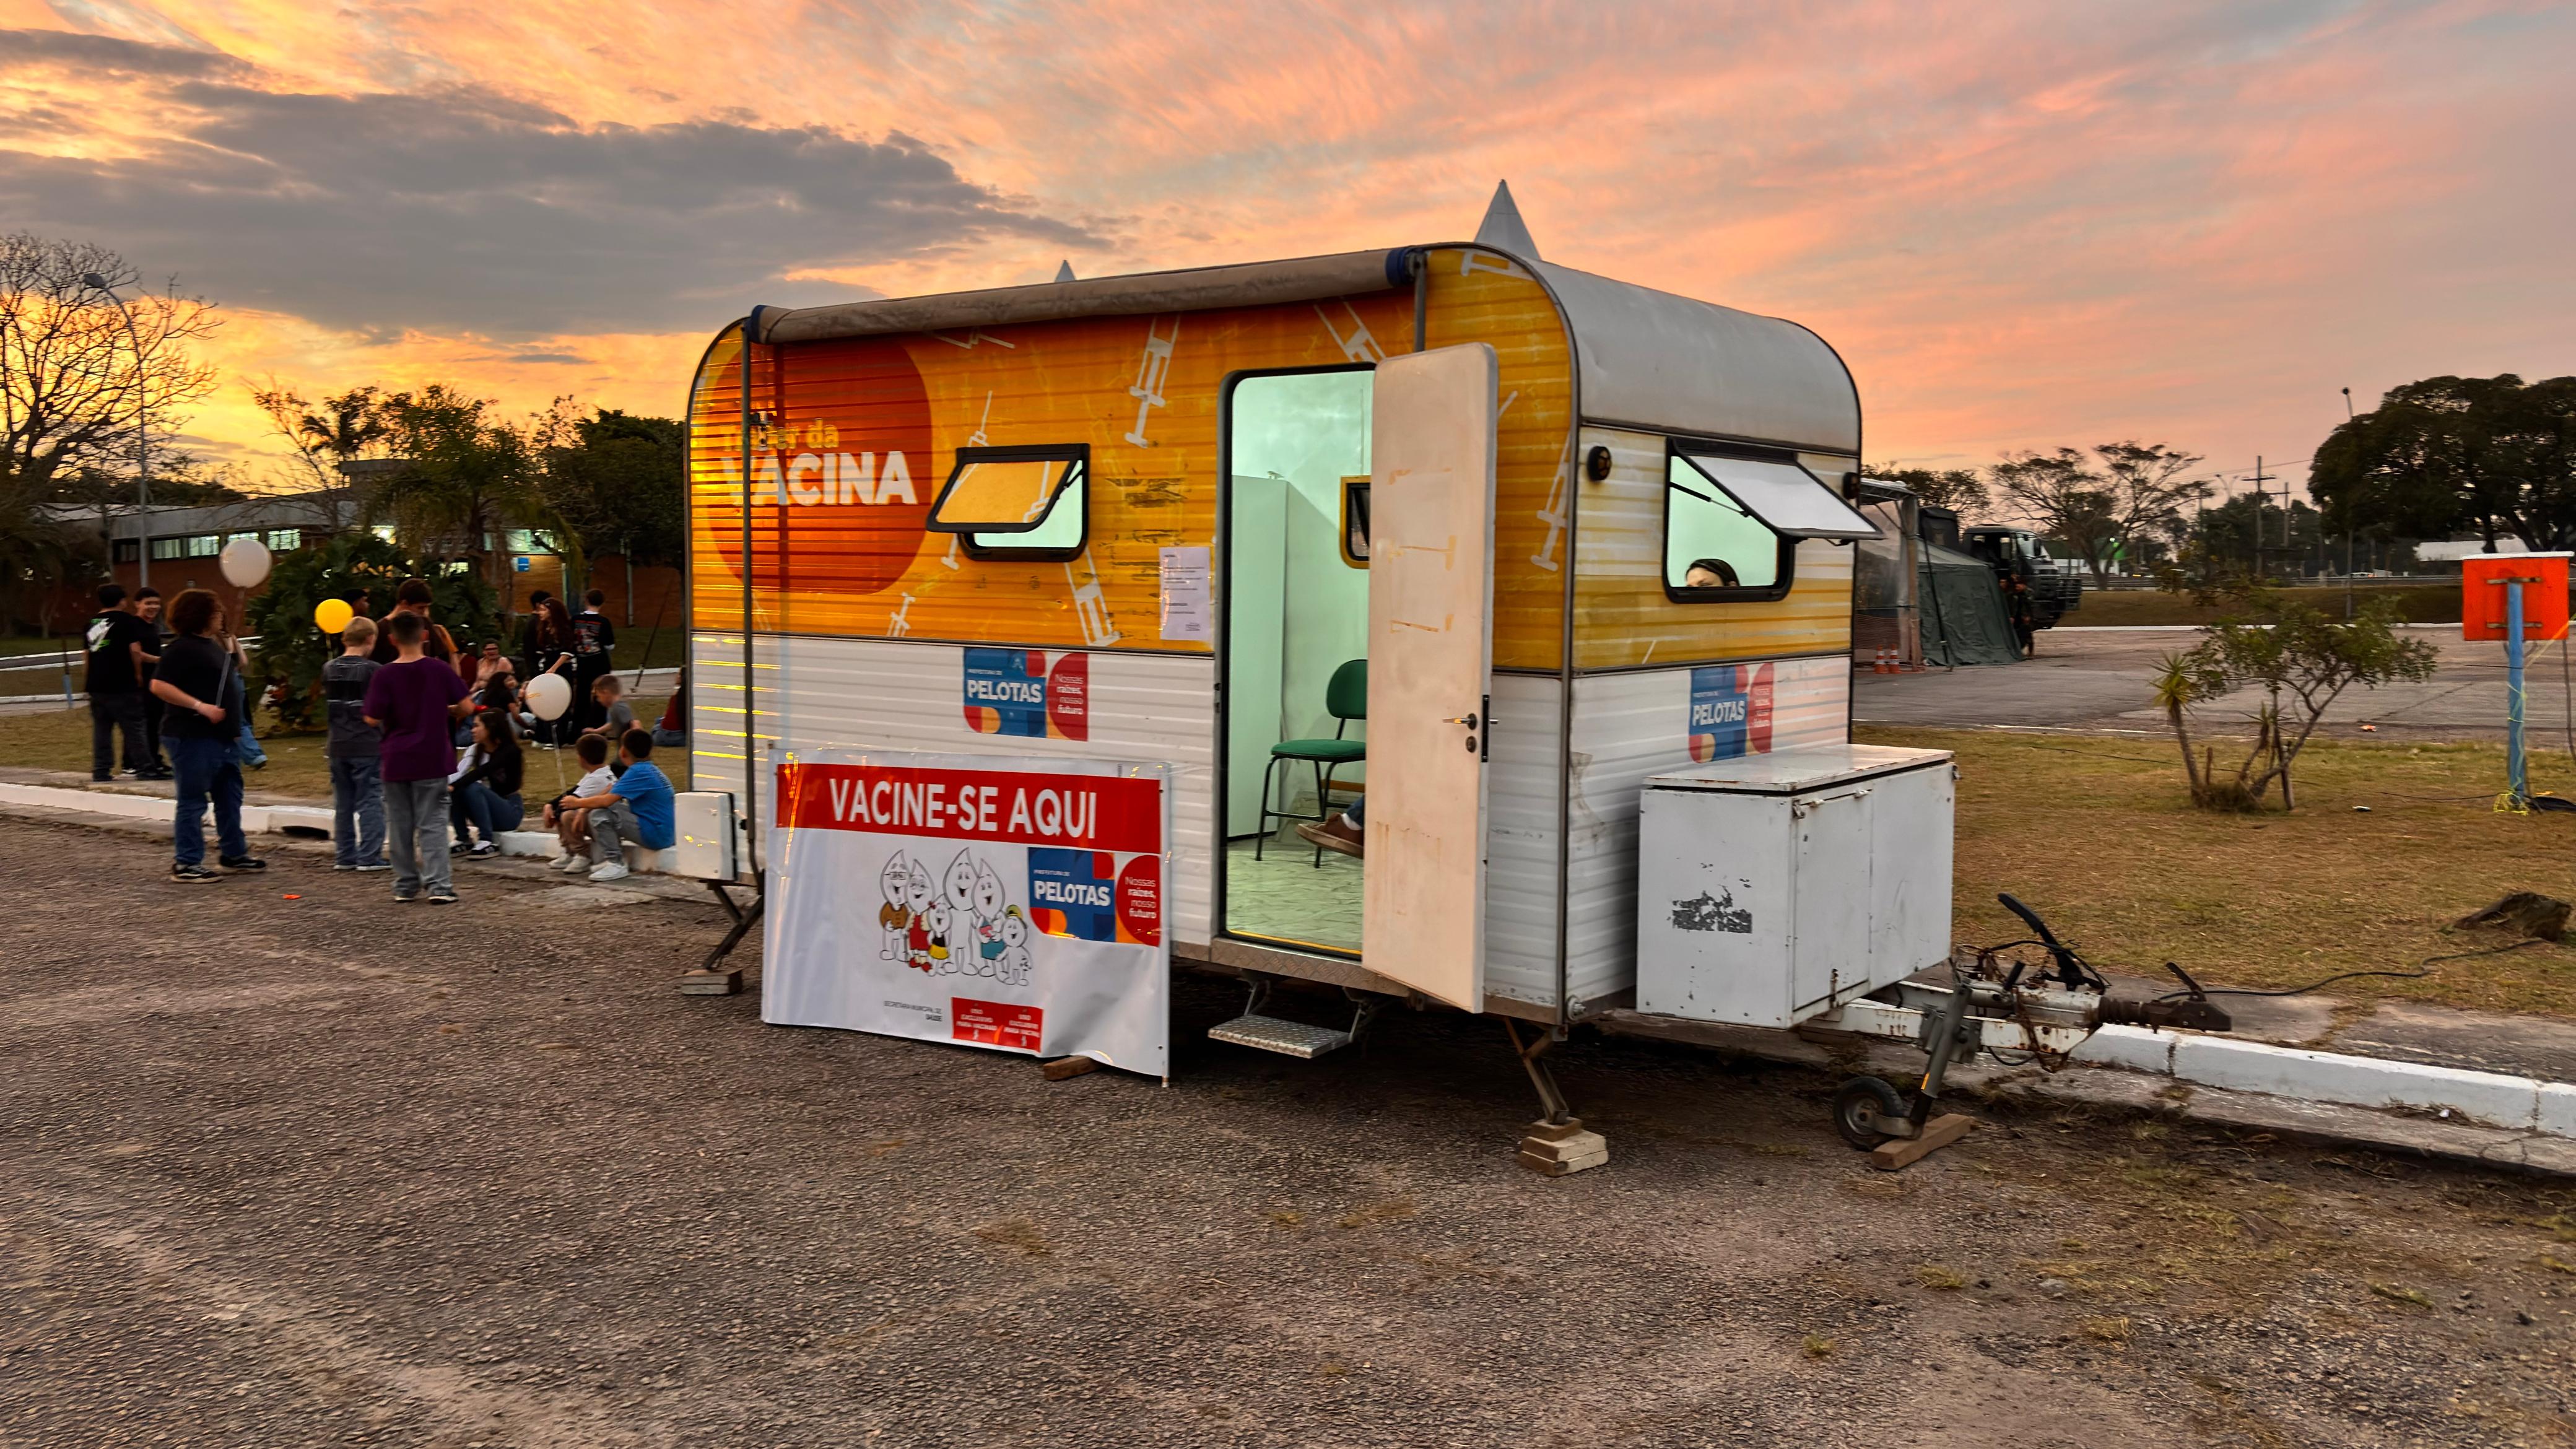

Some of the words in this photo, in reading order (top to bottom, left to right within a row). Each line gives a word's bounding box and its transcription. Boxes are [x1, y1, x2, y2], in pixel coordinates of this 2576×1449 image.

[807, 417, 839, 449] da
[720, 451, 919, 507] VACINA
[967, 679, 1043, 703] PELOTAS
[1692, 700, 1745, 726] PELOTAS
[829, 778, 999, 832] VACINE-SE
[1007, 787, 1097, 839] AQUI
[1034, 880, 1111, 907] PELOTAS
[1125, 876, 1156, 887] Nossas
[1129, 908, 1157, 919] futuro
[1131, 899, 1157, 909] nosso
